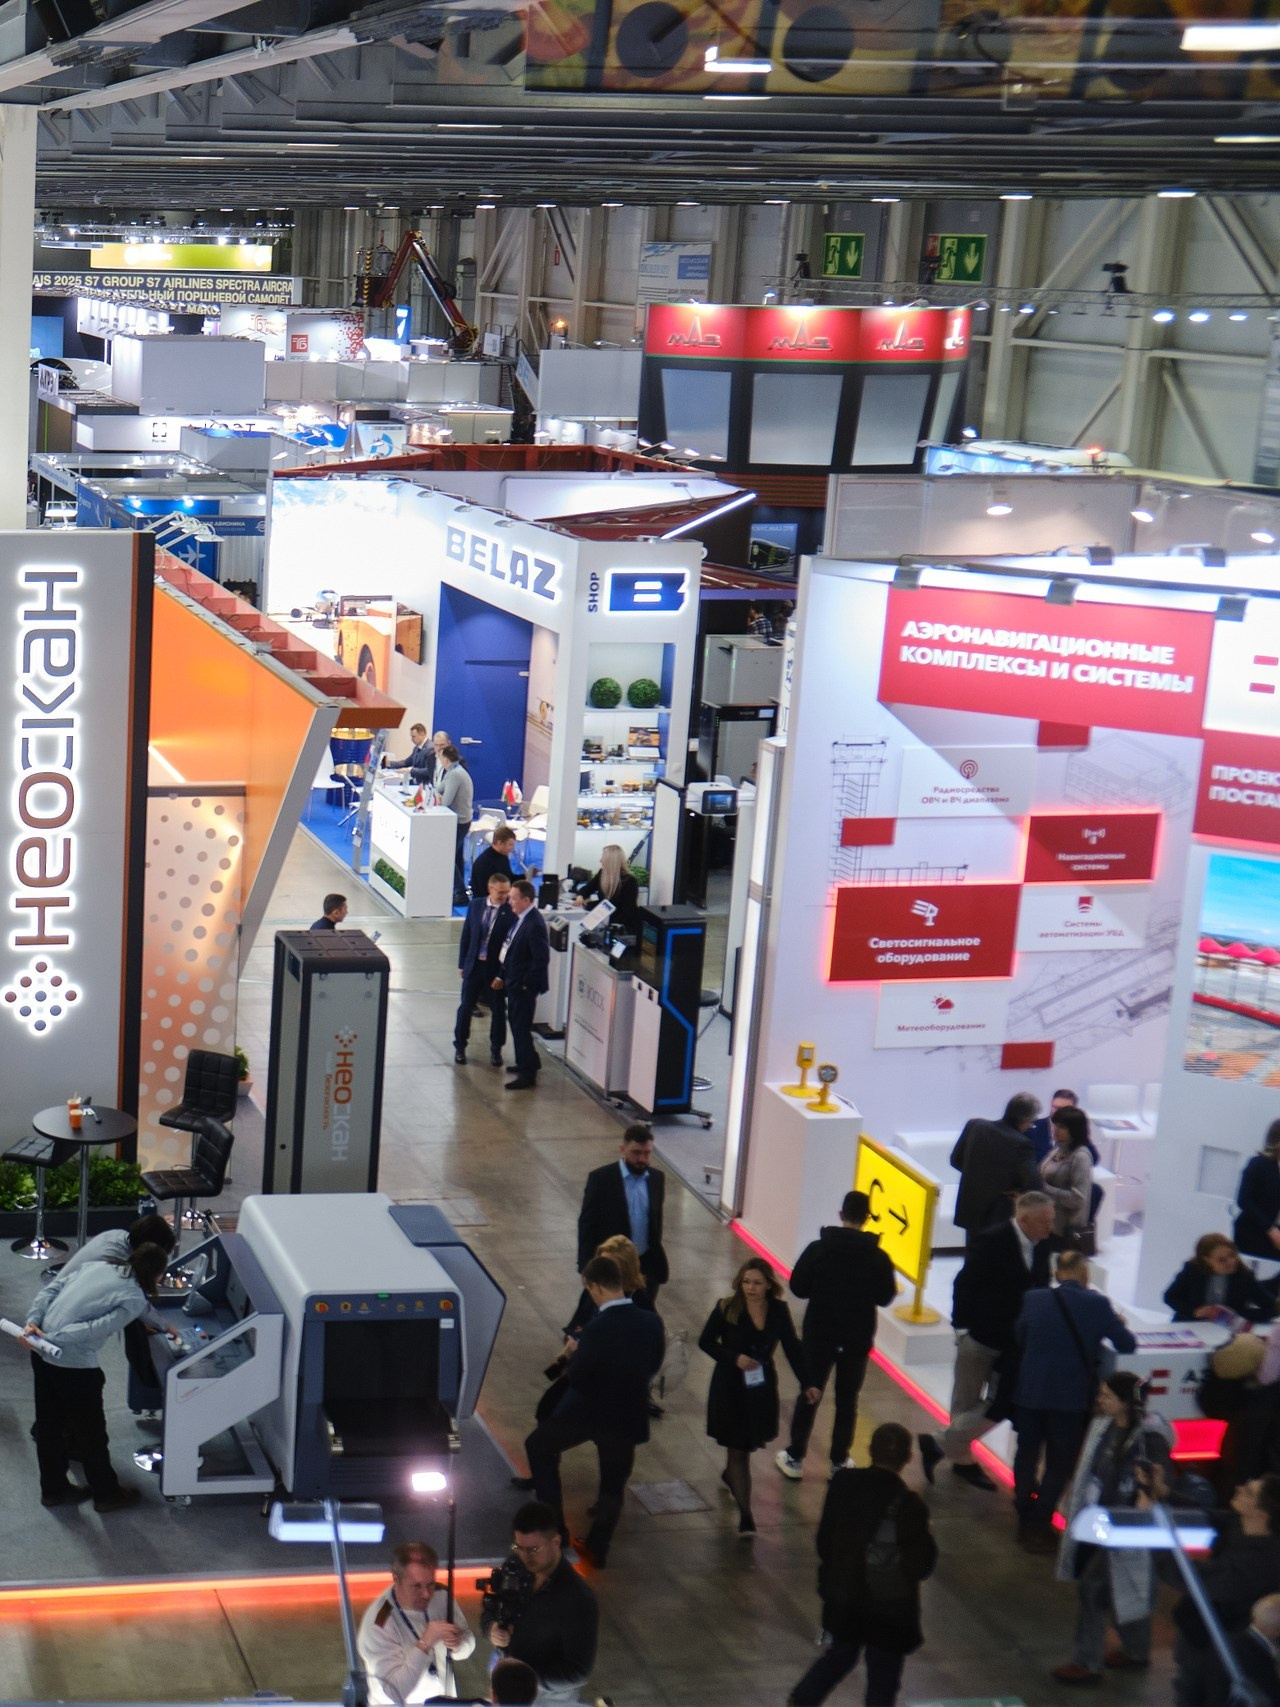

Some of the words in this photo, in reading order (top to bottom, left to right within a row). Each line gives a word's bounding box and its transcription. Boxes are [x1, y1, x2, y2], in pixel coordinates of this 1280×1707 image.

[54, 275, 82, 286] 2025
[85, 275, 99, 287] S7
[102, 276, 144, 287] GROUP
[147, 277, 161, 287] S7
[163, 278, 213, 289] AIRLINES
[216, 279, 260, 291] SPECTRA
[177, 287, 246, 304] ПОРШНЕВОЙ
[248, 292, 290, 306] САМОЛЁТ
[445, 524, 557, 601] BELAZ
[588, 571, 601, 613] SHOP
[901, 620, 1176, 666] АЭРОНАВИГАЦИОННЫЕ
[899, 645, 1047, 679] КОМПЛЕКСЫ
[1050, 662, 1070, 681] И
[1072, 663, 1195, 694] СИСТЕМЫ
[933, 786, 1000, 795] Радиосредства
[963, 796, 1010, 805] диапазона
[1056, 853, 1126, 862] Навигационные
[1072, 863, 1110, 872] системы
[1064, 920, 1102, 929] Системы
[1039, 930, 1106, 939] автоматизации
[868, 936, 981, 949] Светосигнальное
[876, 951, 971, 966] оборудование
[896, 1022, 986, 1033] Метеооборудование
